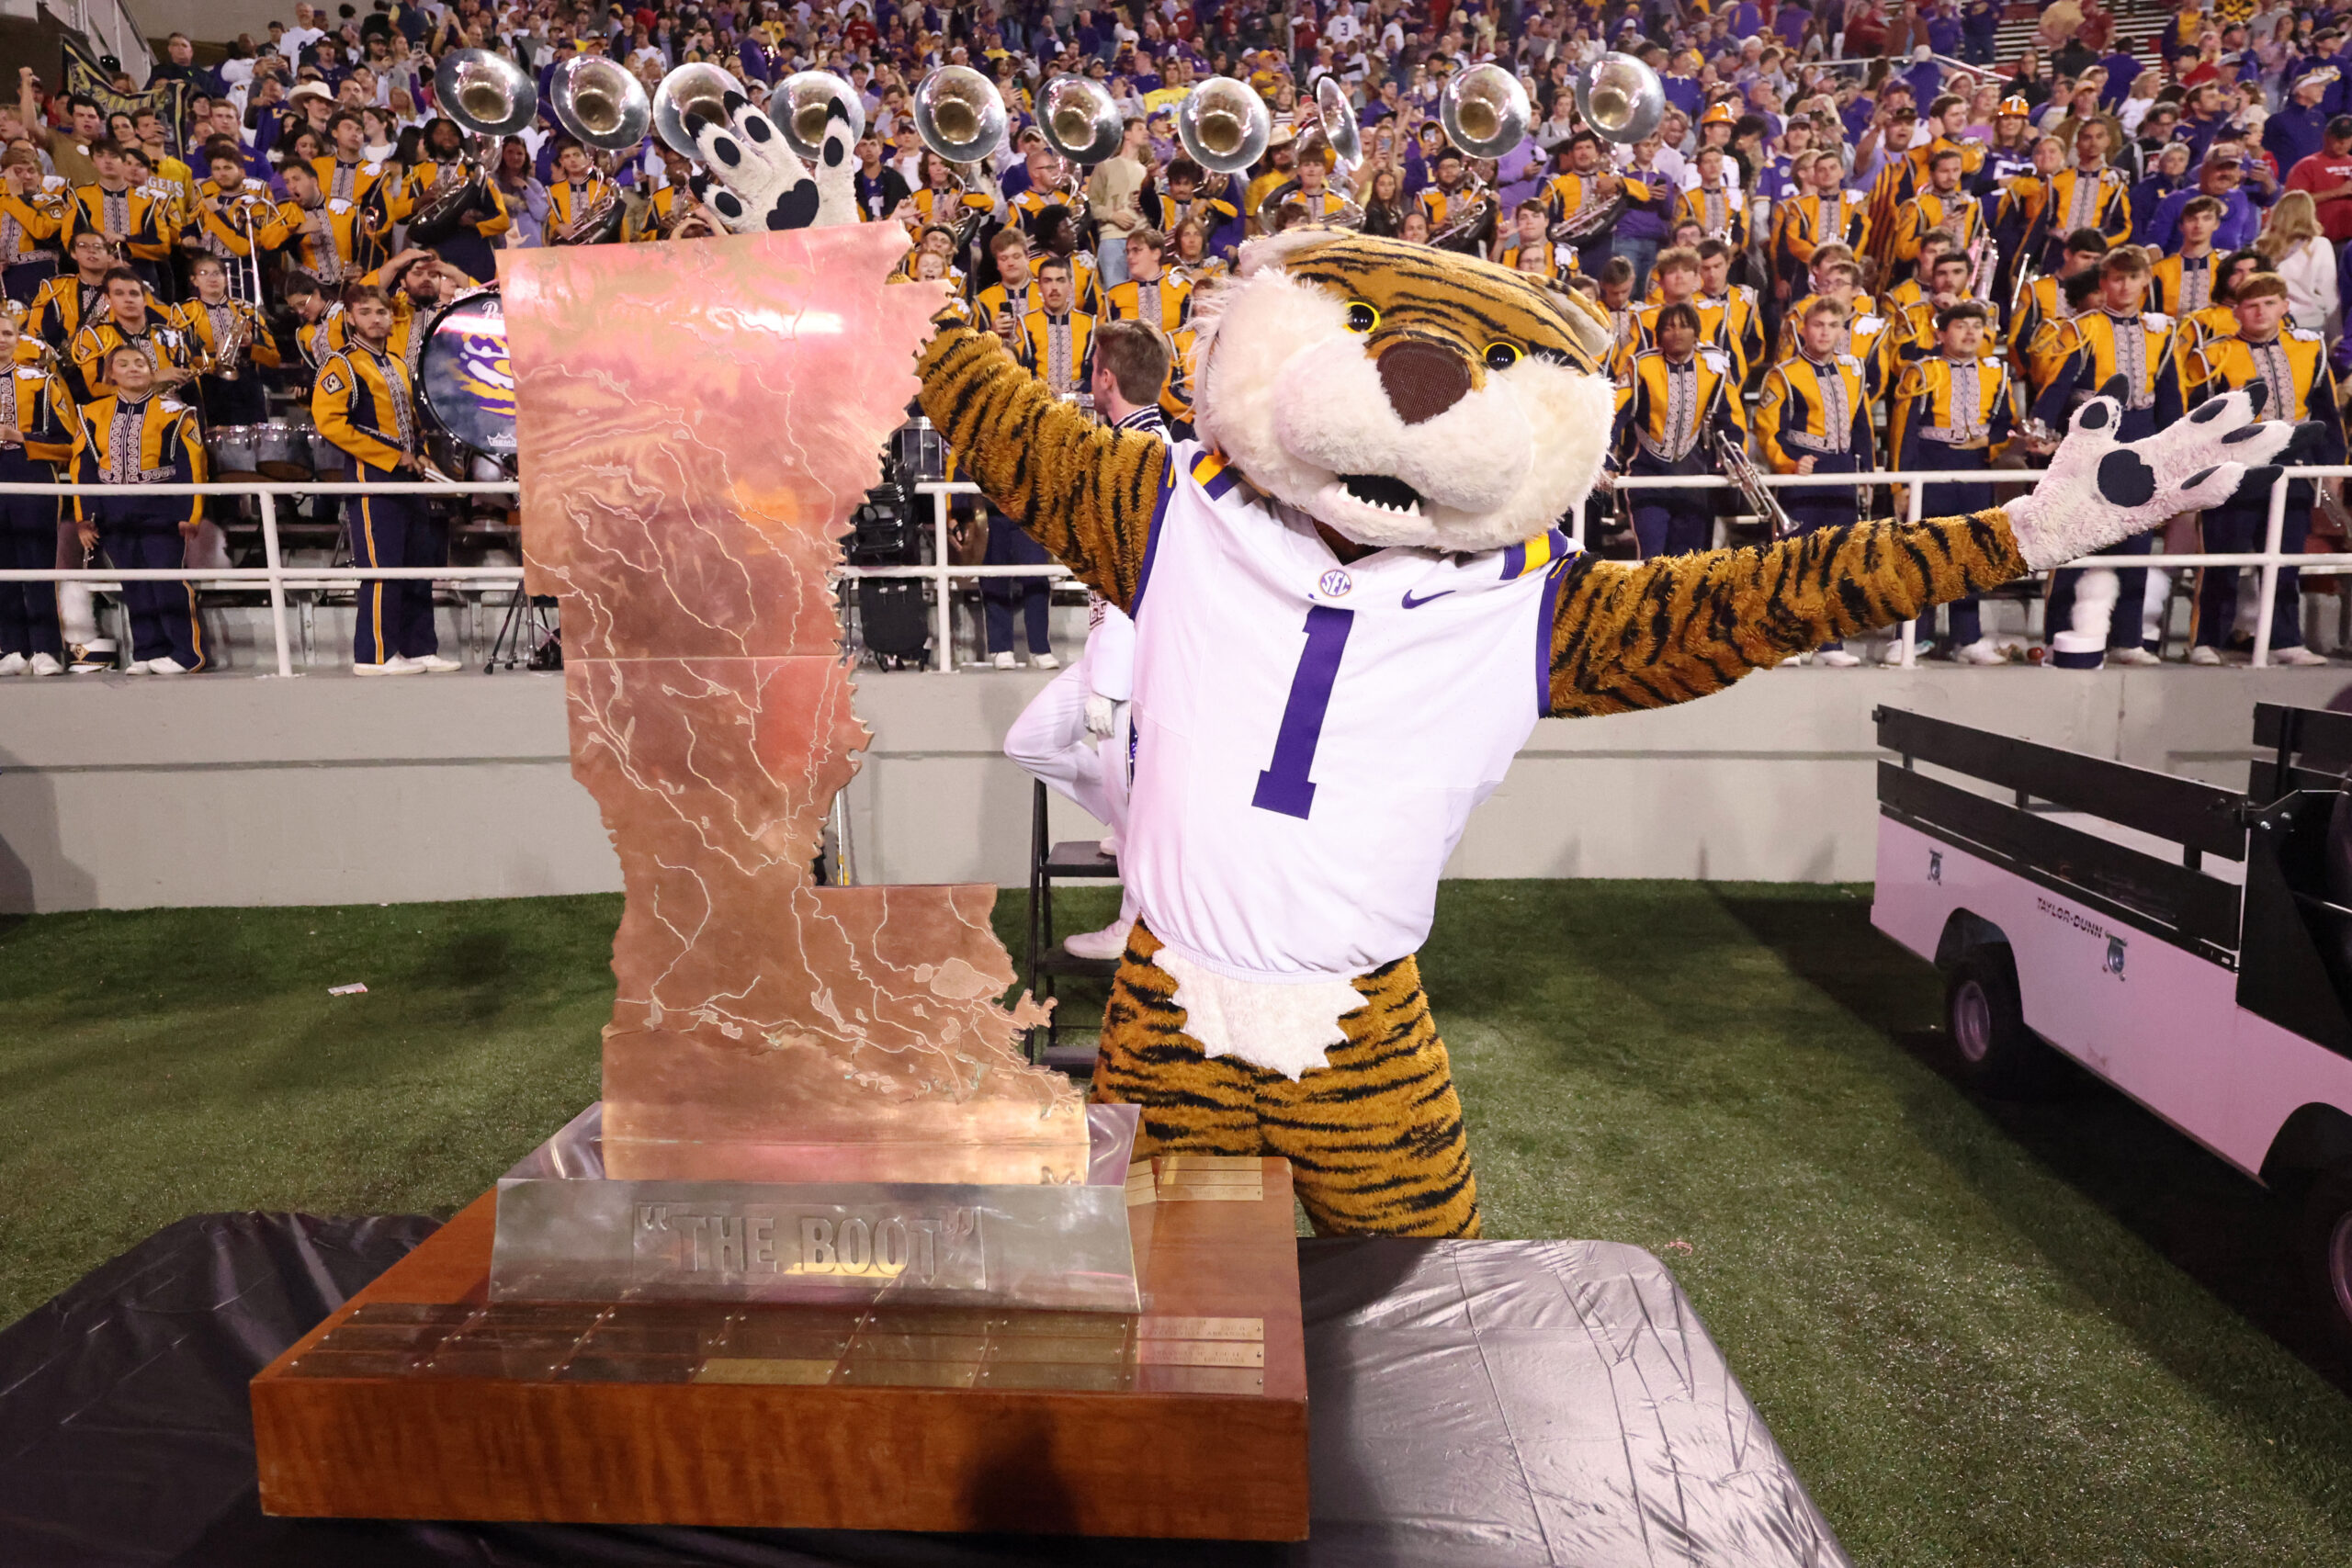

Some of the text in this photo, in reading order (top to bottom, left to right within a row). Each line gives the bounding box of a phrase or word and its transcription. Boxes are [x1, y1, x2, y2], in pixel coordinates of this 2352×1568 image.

[1340, 22, 1349, 36] 3
[148, 175, 186, 199] GERS
[1320, 570, 1351, 596] SEC
[1251, 604, 1354, 820] 1
[2037, 897, 2103, 939] TAYLOR-DUNN
